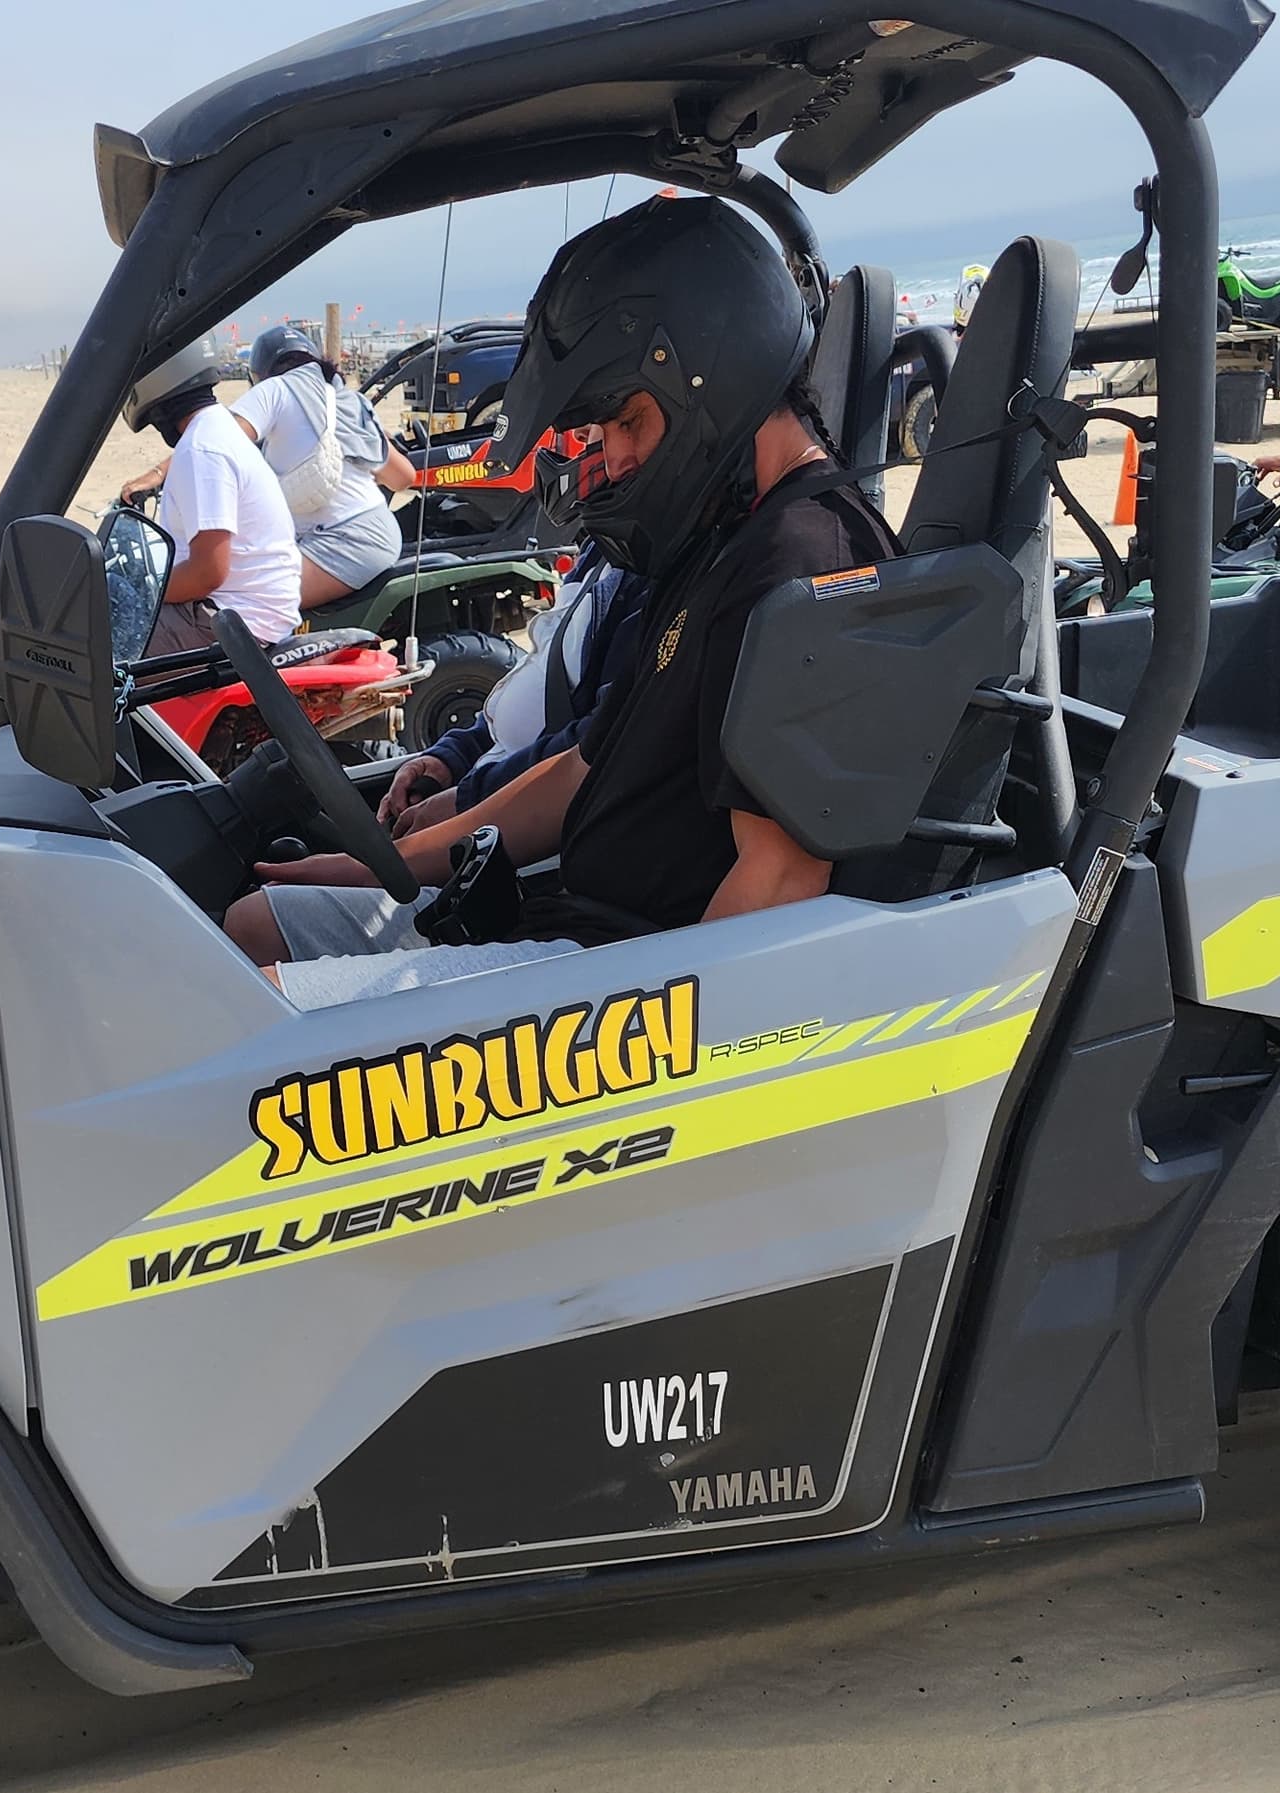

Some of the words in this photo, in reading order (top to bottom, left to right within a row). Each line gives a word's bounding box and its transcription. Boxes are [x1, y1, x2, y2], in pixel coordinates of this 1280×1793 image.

[435, 461, 489, 486] SUNBU
[271, 639, 337, 667] ONDA
[709, 1019, 823, 1062] R-SPEC
[250, 975, 699, 1180] SUNBUGGY
[129, 1157, 548, 1291] WOLVERINE
[553, 1126, 677, 1187] X2
[602, 1370, 729, 1448] UW217
[669, 1464, 818, 1514] YAMAHA
